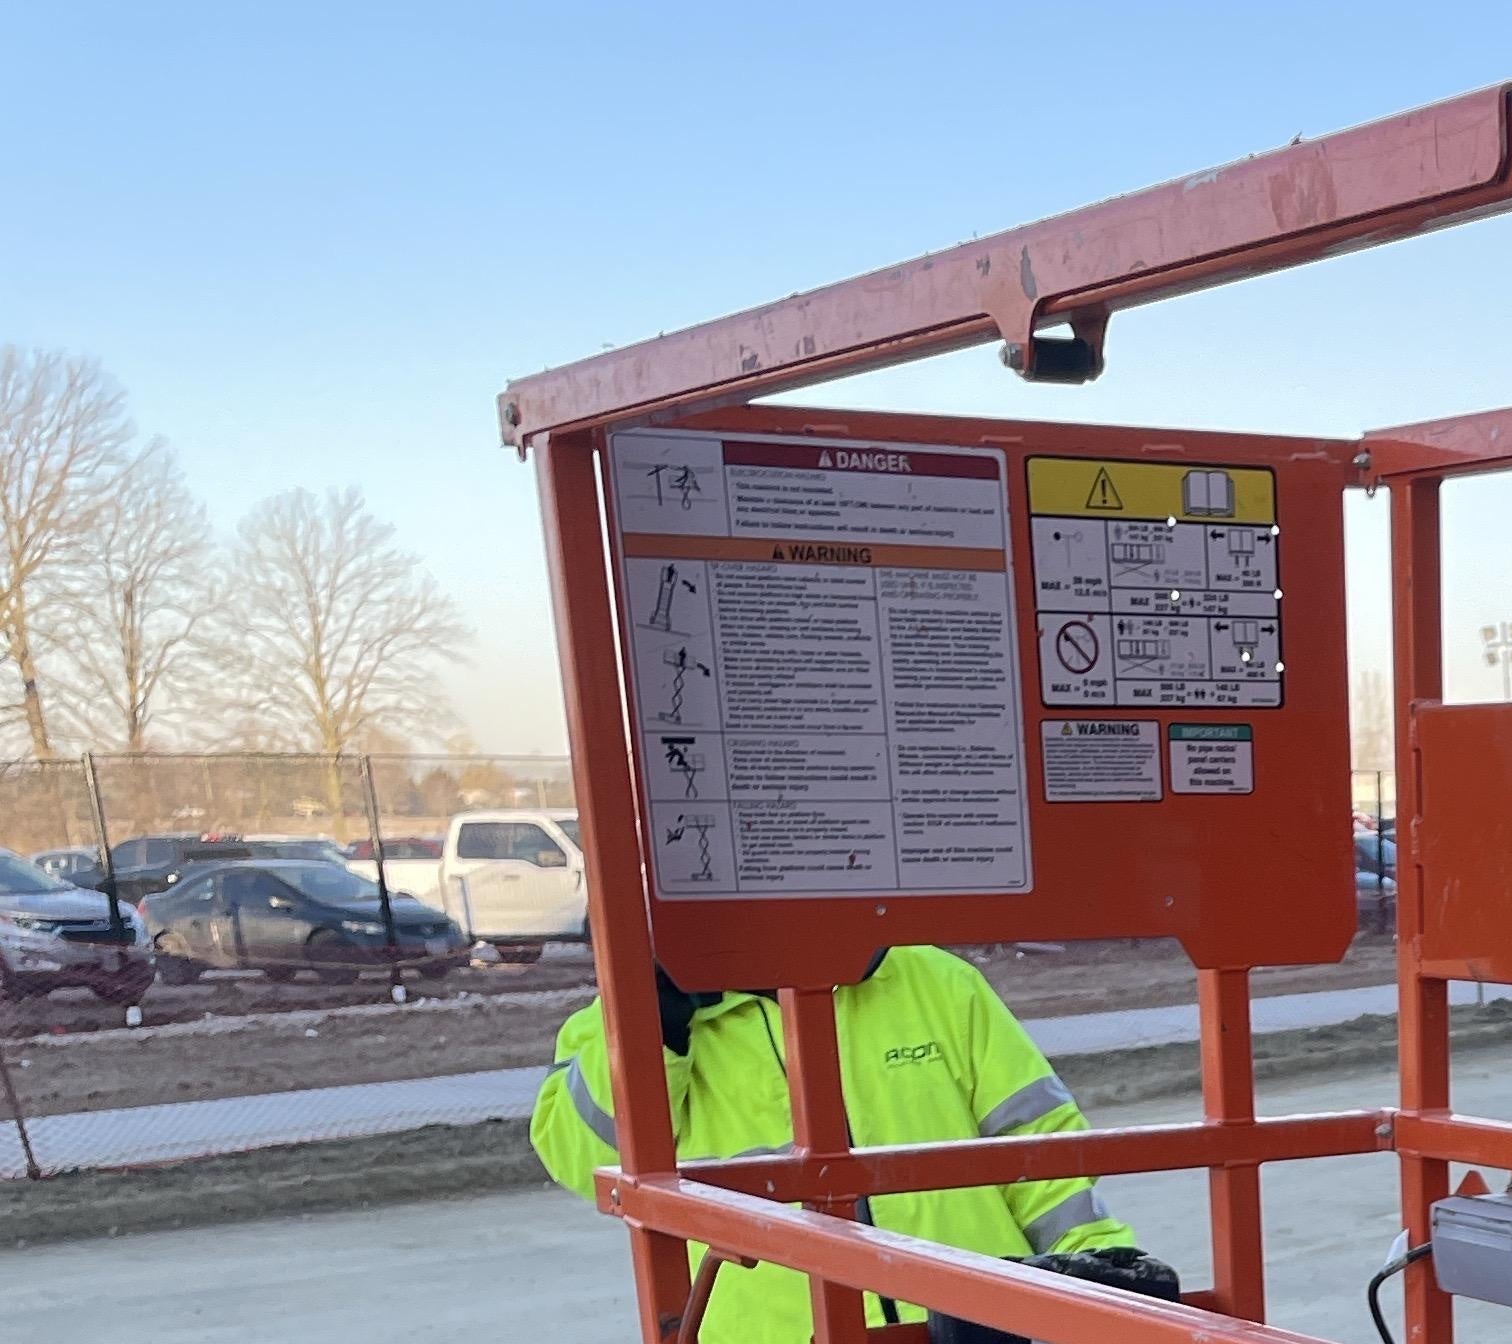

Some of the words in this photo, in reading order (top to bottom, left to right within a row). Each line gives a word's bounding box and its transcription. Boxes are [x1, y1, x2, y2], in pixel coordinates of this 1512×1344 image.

[836, 452, 912, 472] DANGER
[790, 546, 872, 564] WARNING
[1076, 723, 1140, 736] WARNING
[1181, 727, 1239, 738] IMPORTANT
